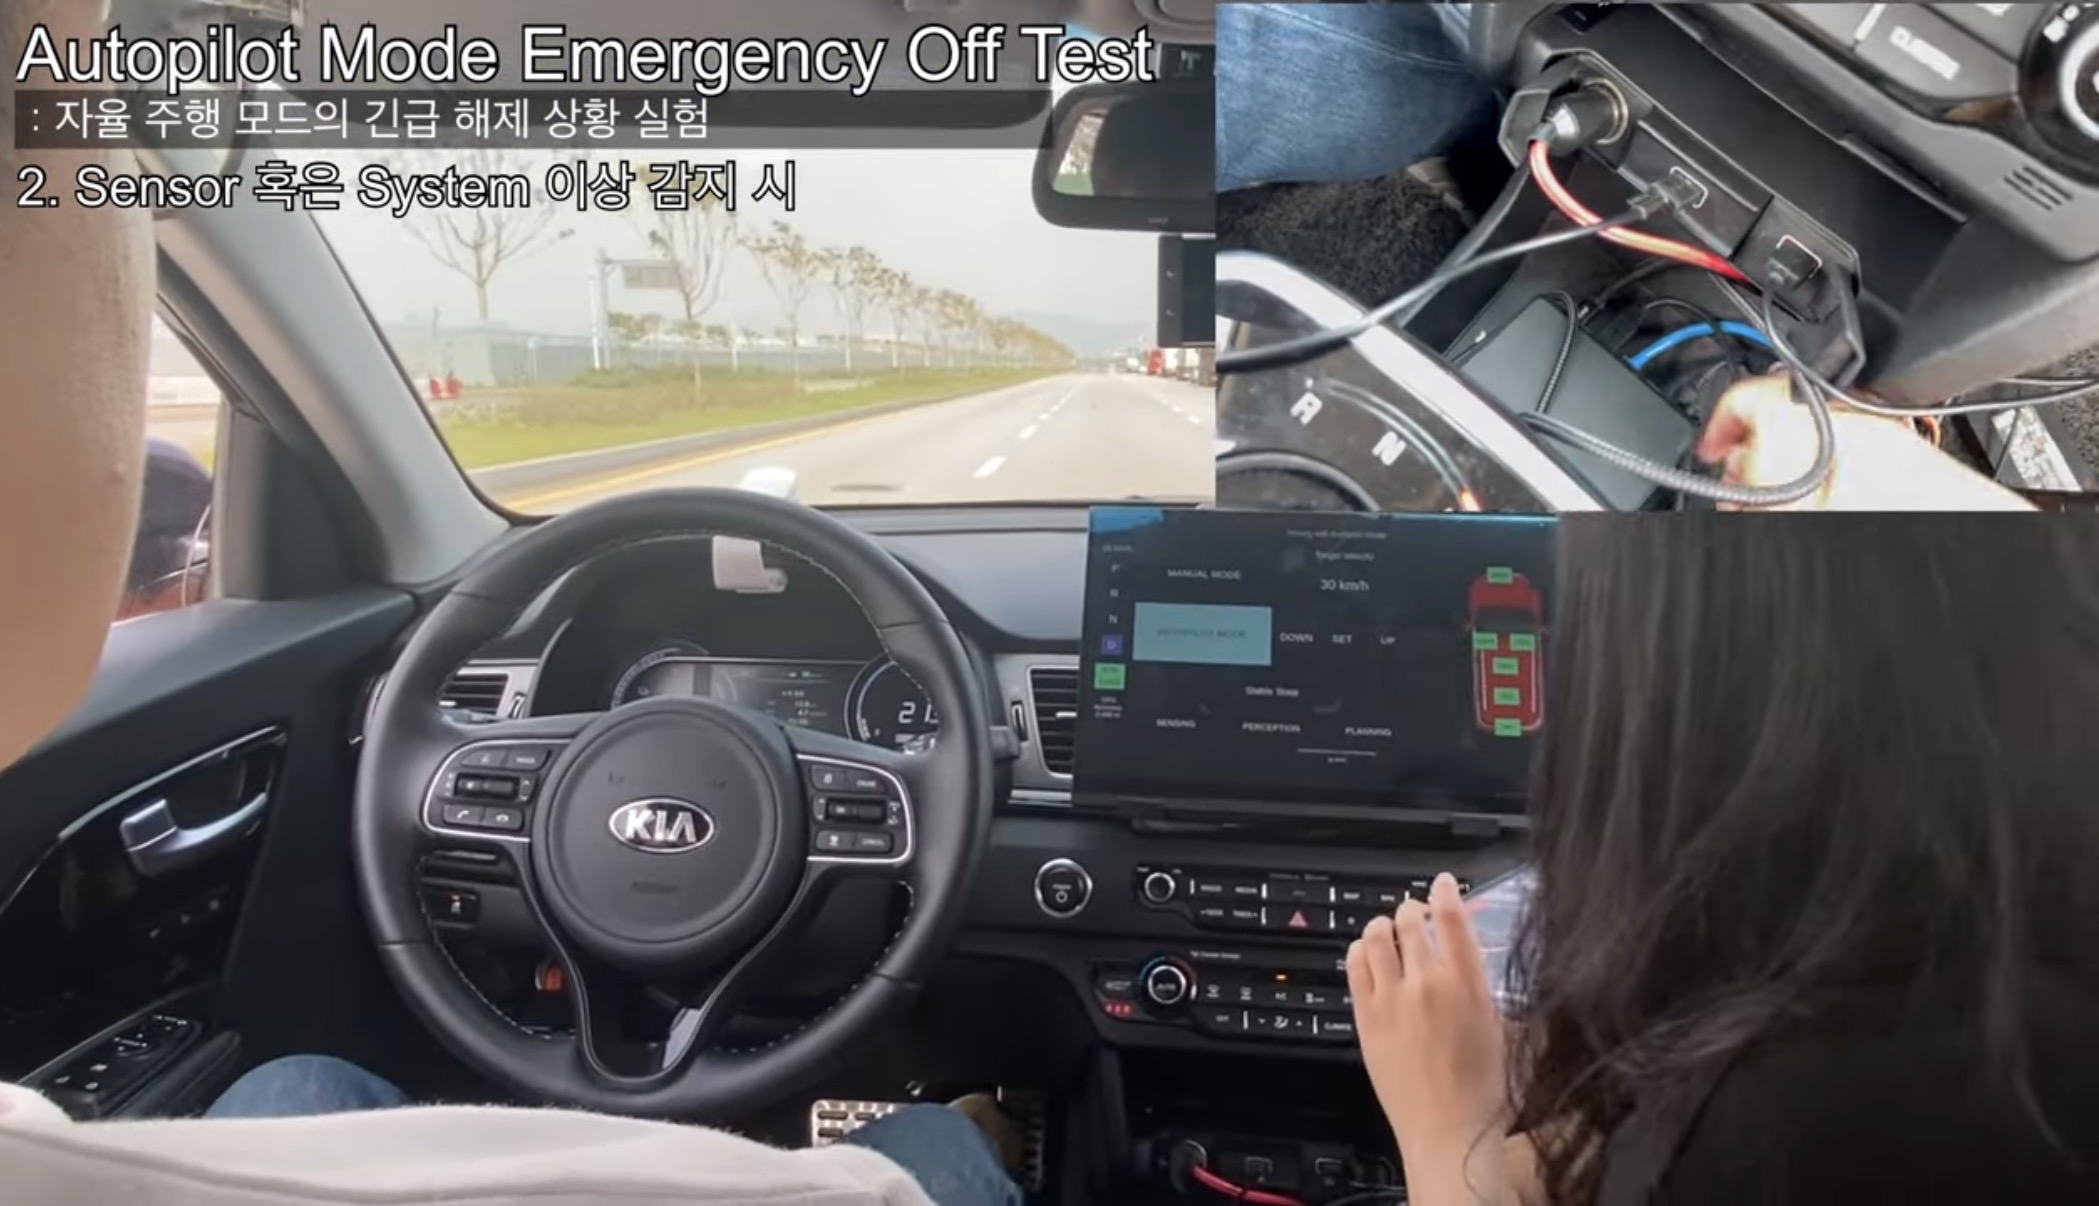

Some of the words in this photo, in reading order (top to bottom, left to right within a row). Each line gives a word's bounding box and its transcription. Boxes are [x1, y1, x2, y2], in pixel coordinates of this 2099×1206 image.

[1211, 570, 1242, 580] MODE
[1320, 579, 1337, 591] 30
[1338, 579, 1370, 592] km/h
[1279, 632, 1314, 643] DOWN
[1331, 634, 1353, 645] SET
[1242, 721, 1301, 733] PERCEPTION
[625, 808, 698, 843] KIA
